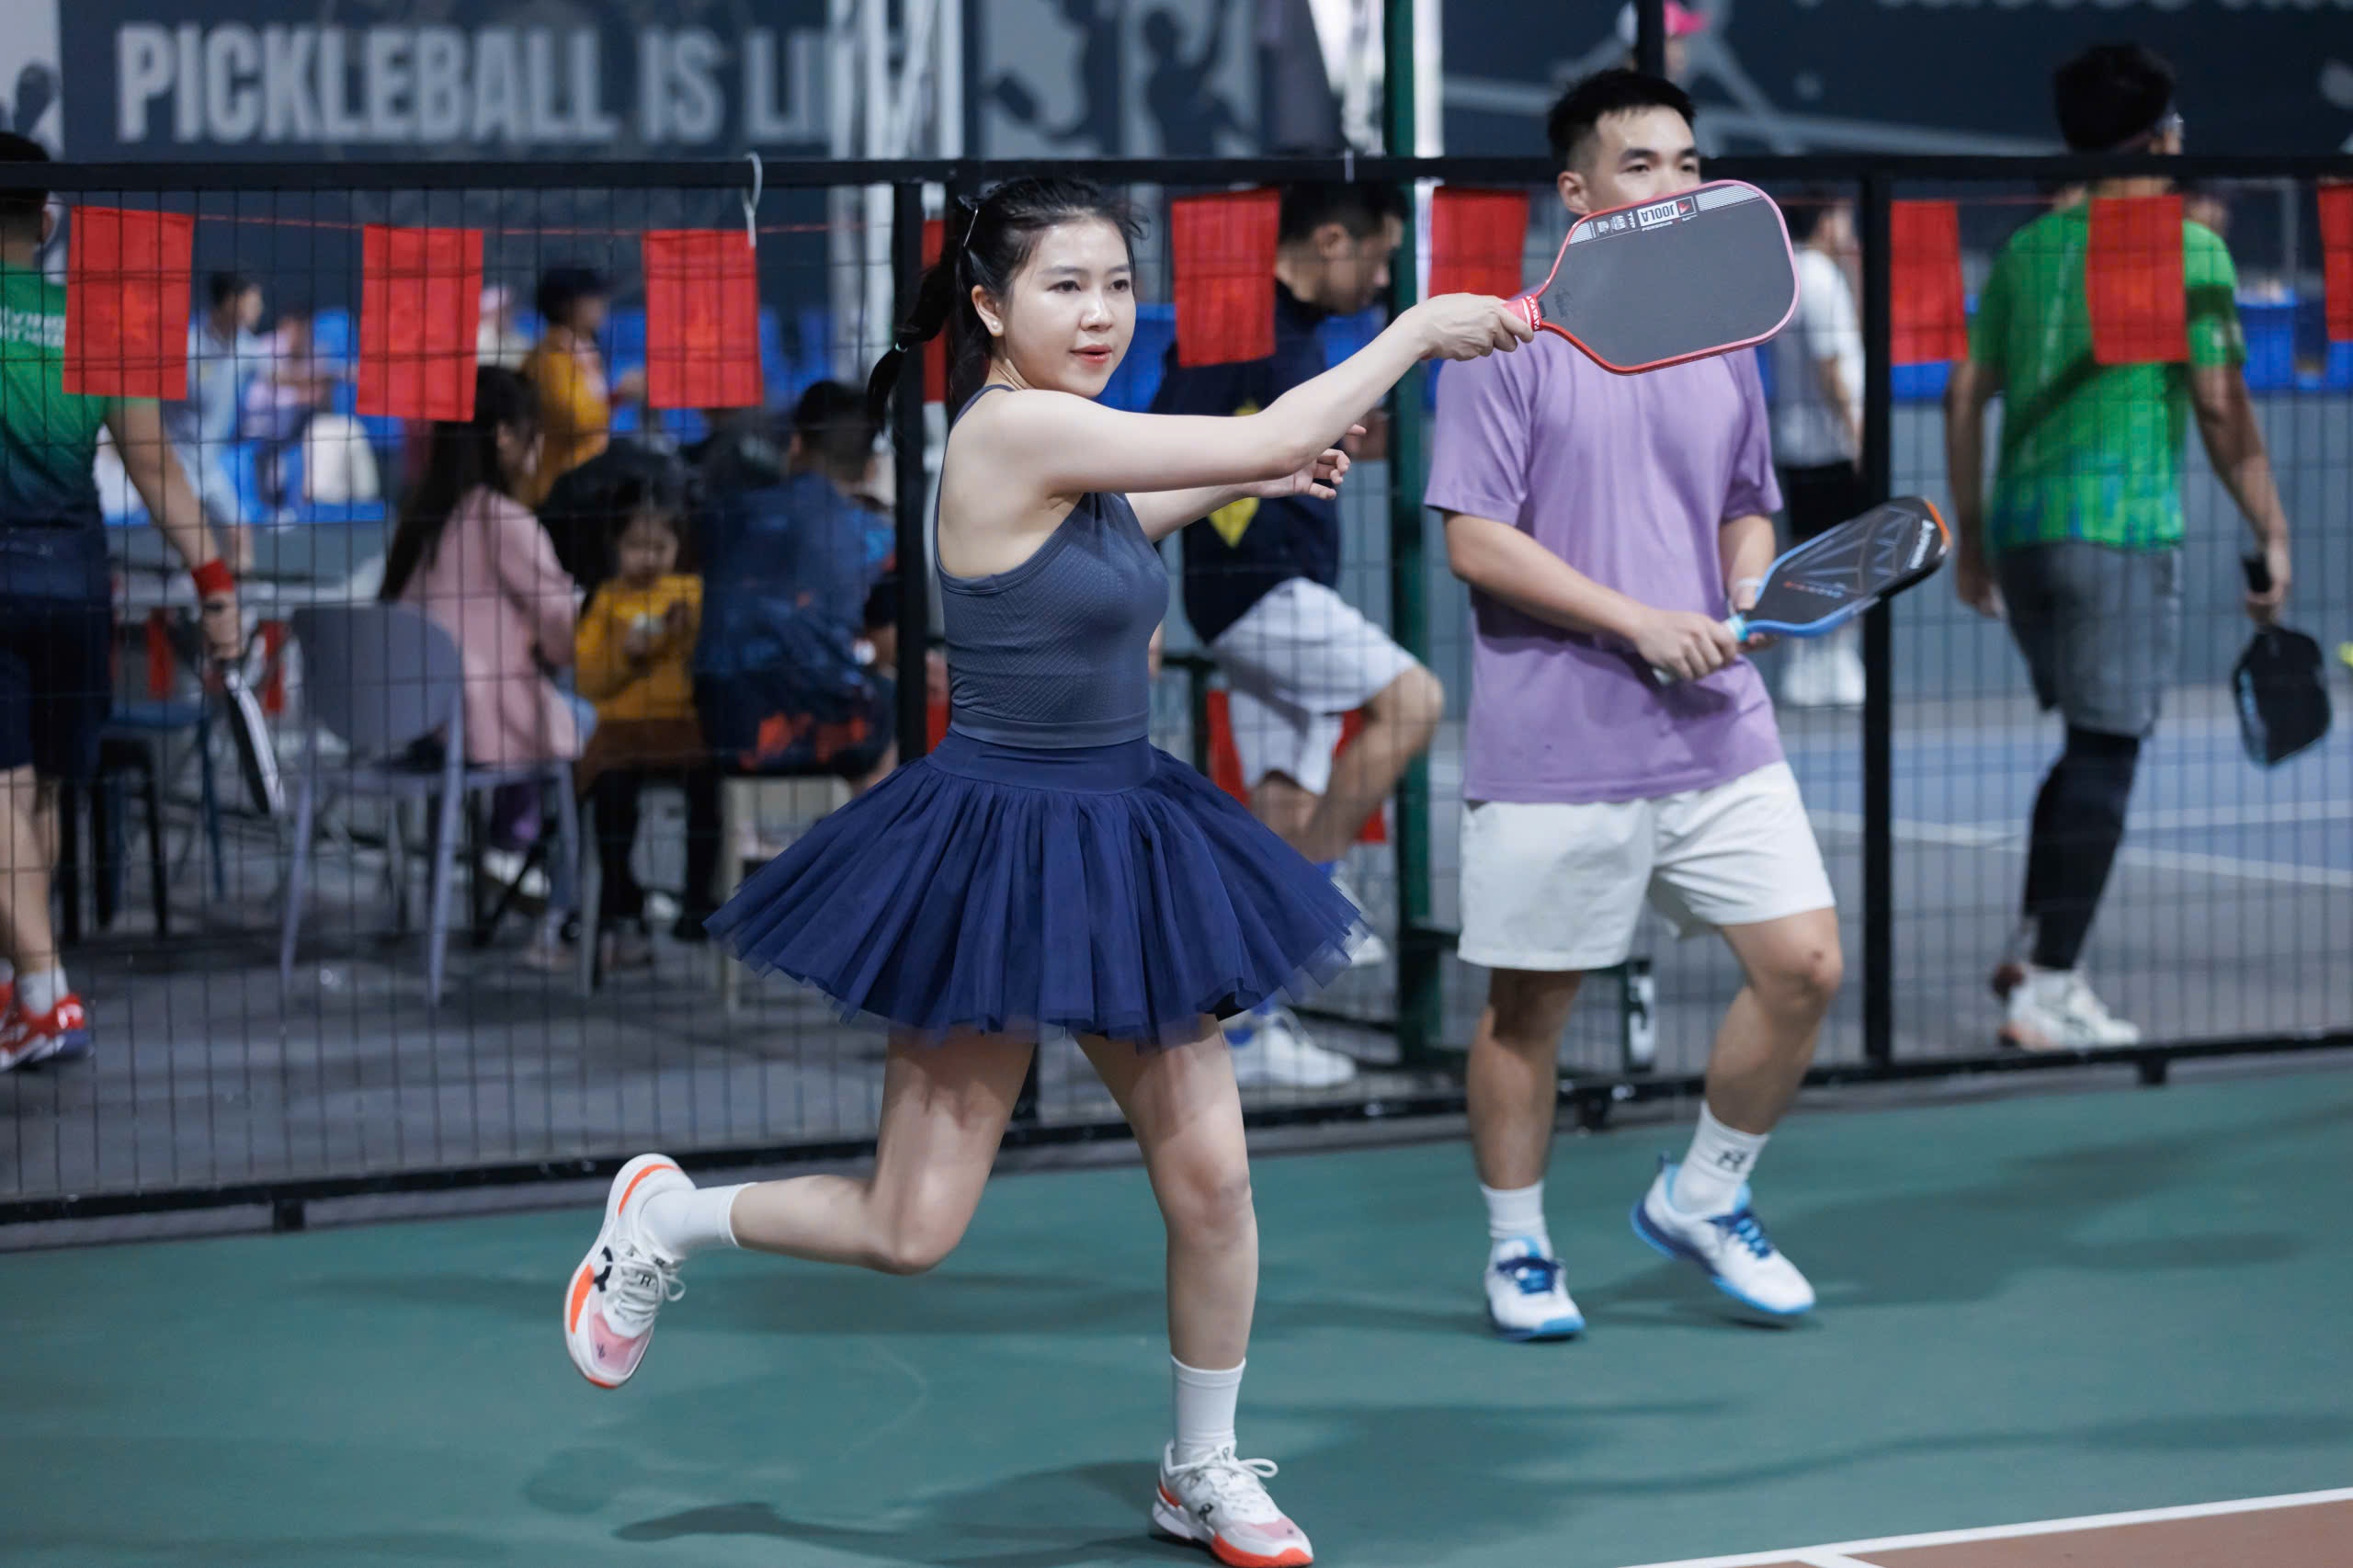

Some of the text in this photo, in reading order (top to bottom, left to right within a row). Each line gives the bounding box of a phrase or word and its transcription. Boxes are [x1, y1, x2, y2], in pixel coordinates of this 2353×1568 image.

[117, 23, 615, 142] PICKLEBALL
[637, 26, 726, 144] IS
[1640, 204, 1674, 222] JOOLA
